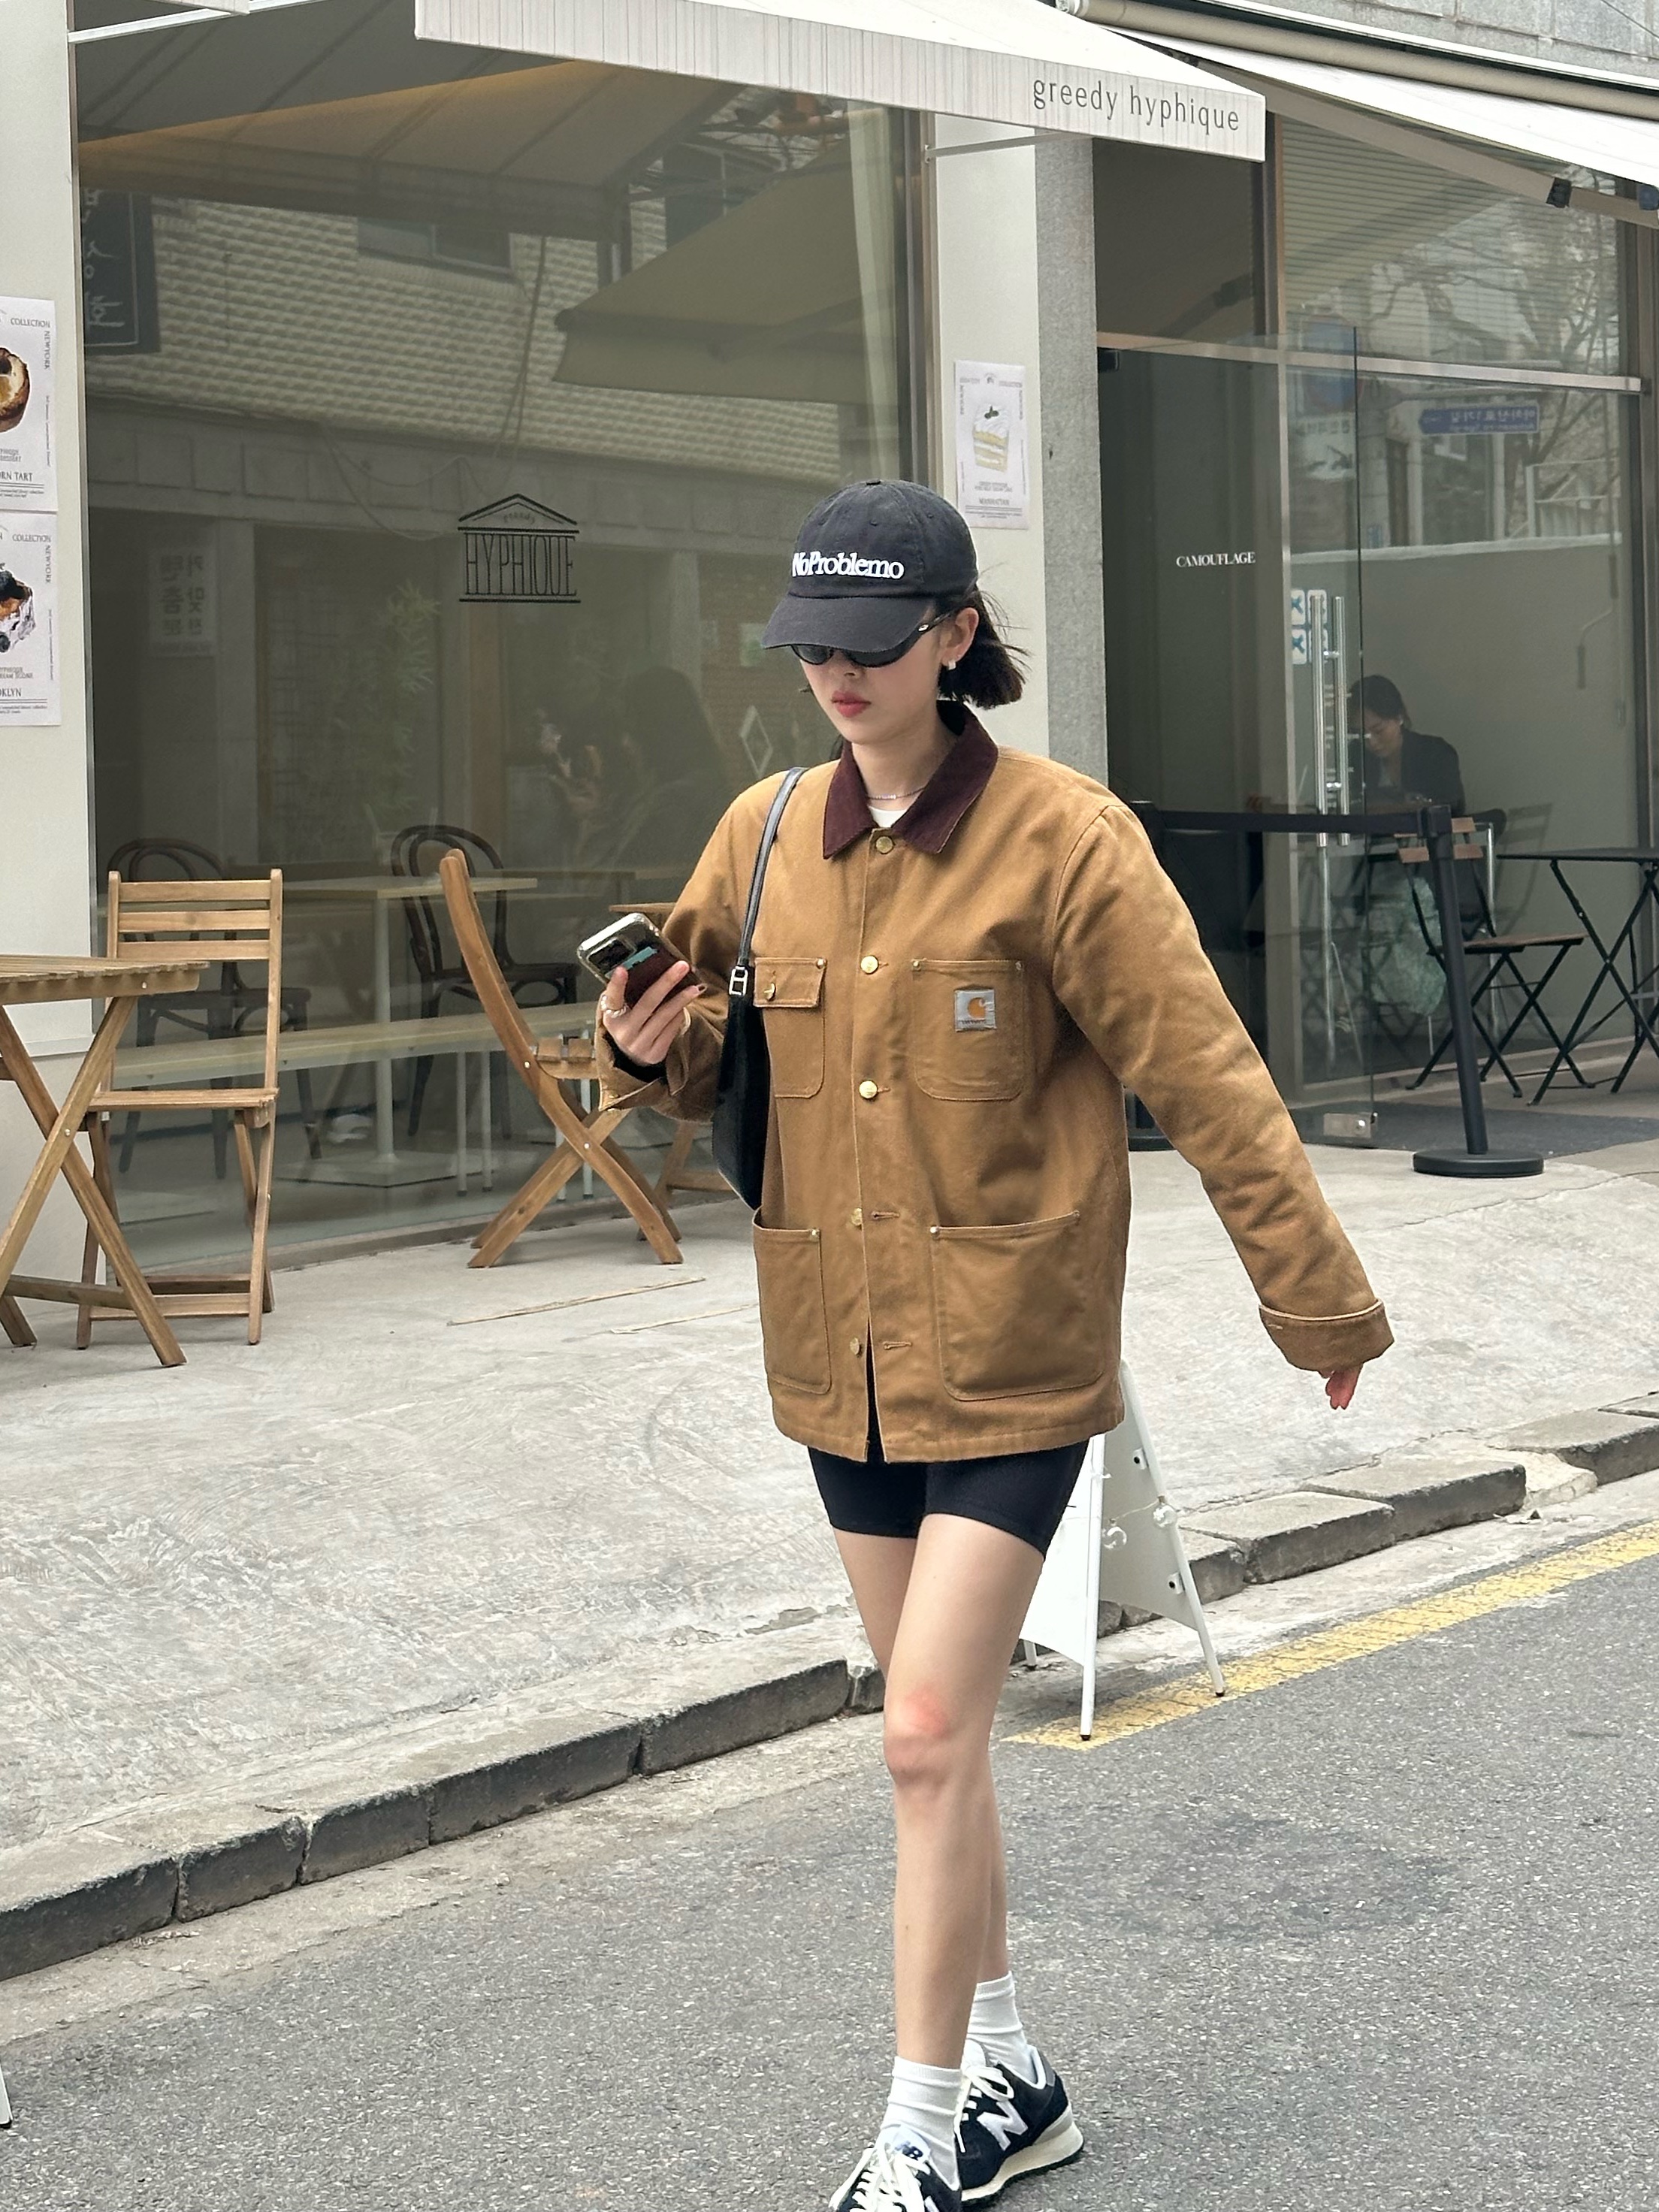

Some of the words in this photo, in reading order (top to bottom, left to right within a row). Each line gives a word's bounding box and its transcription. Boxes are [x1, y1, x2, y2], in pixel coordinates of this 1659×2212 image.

[1033, 80, 1118, 120] greedy
[1129, 85, 1240, 135] hyphique
[11, 317, 50, 328] COLLECTION
[14, 472, 33, 482] TART
[12, 533, 51, 542] COLLECTION
[1176, 551, 1256, 568] CAMOUFLAGE
